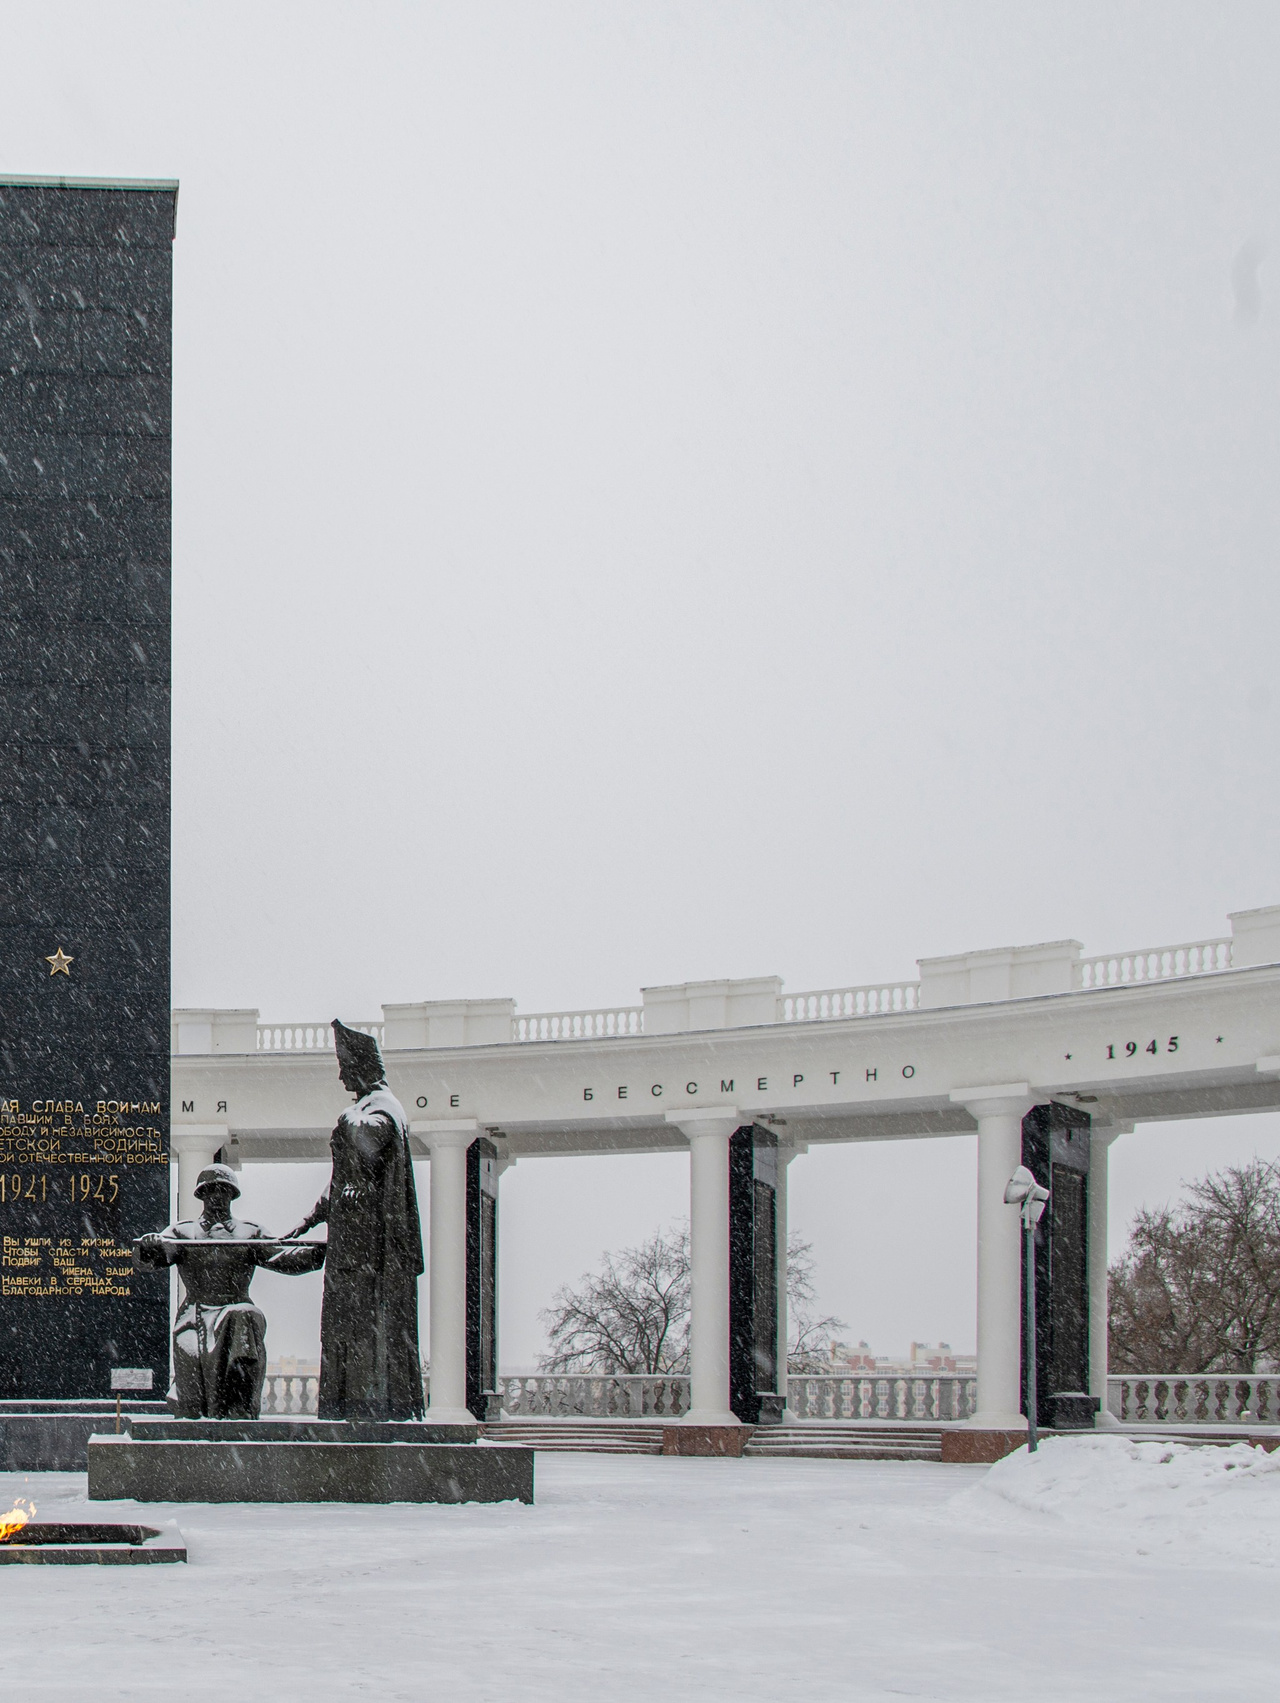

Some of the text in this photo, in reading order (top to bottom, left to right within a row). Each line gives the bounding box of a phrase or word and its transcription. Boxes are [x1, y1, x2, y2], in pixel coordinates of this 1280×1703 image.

[1106, 1036, 1179, 1060] 1945
[181, 1100, 227, 1113] МЯ
[583, 1065, 915, 1101] БЕССМЕРТНО
[32, 1100, 84, 1113] СЛАВА
[97, 1100, 160, 1114] ВОИНАМ
[0, 1114, 119, 1125] ПАВШИМ В БОЯХ
[52, 1126, 161, 1138] НЕЗАВИСИМОСТЬ
[93, 1138, 162, 1153] РОДИНЫ
[0, 1174, 119, 1203] 1941 1945
